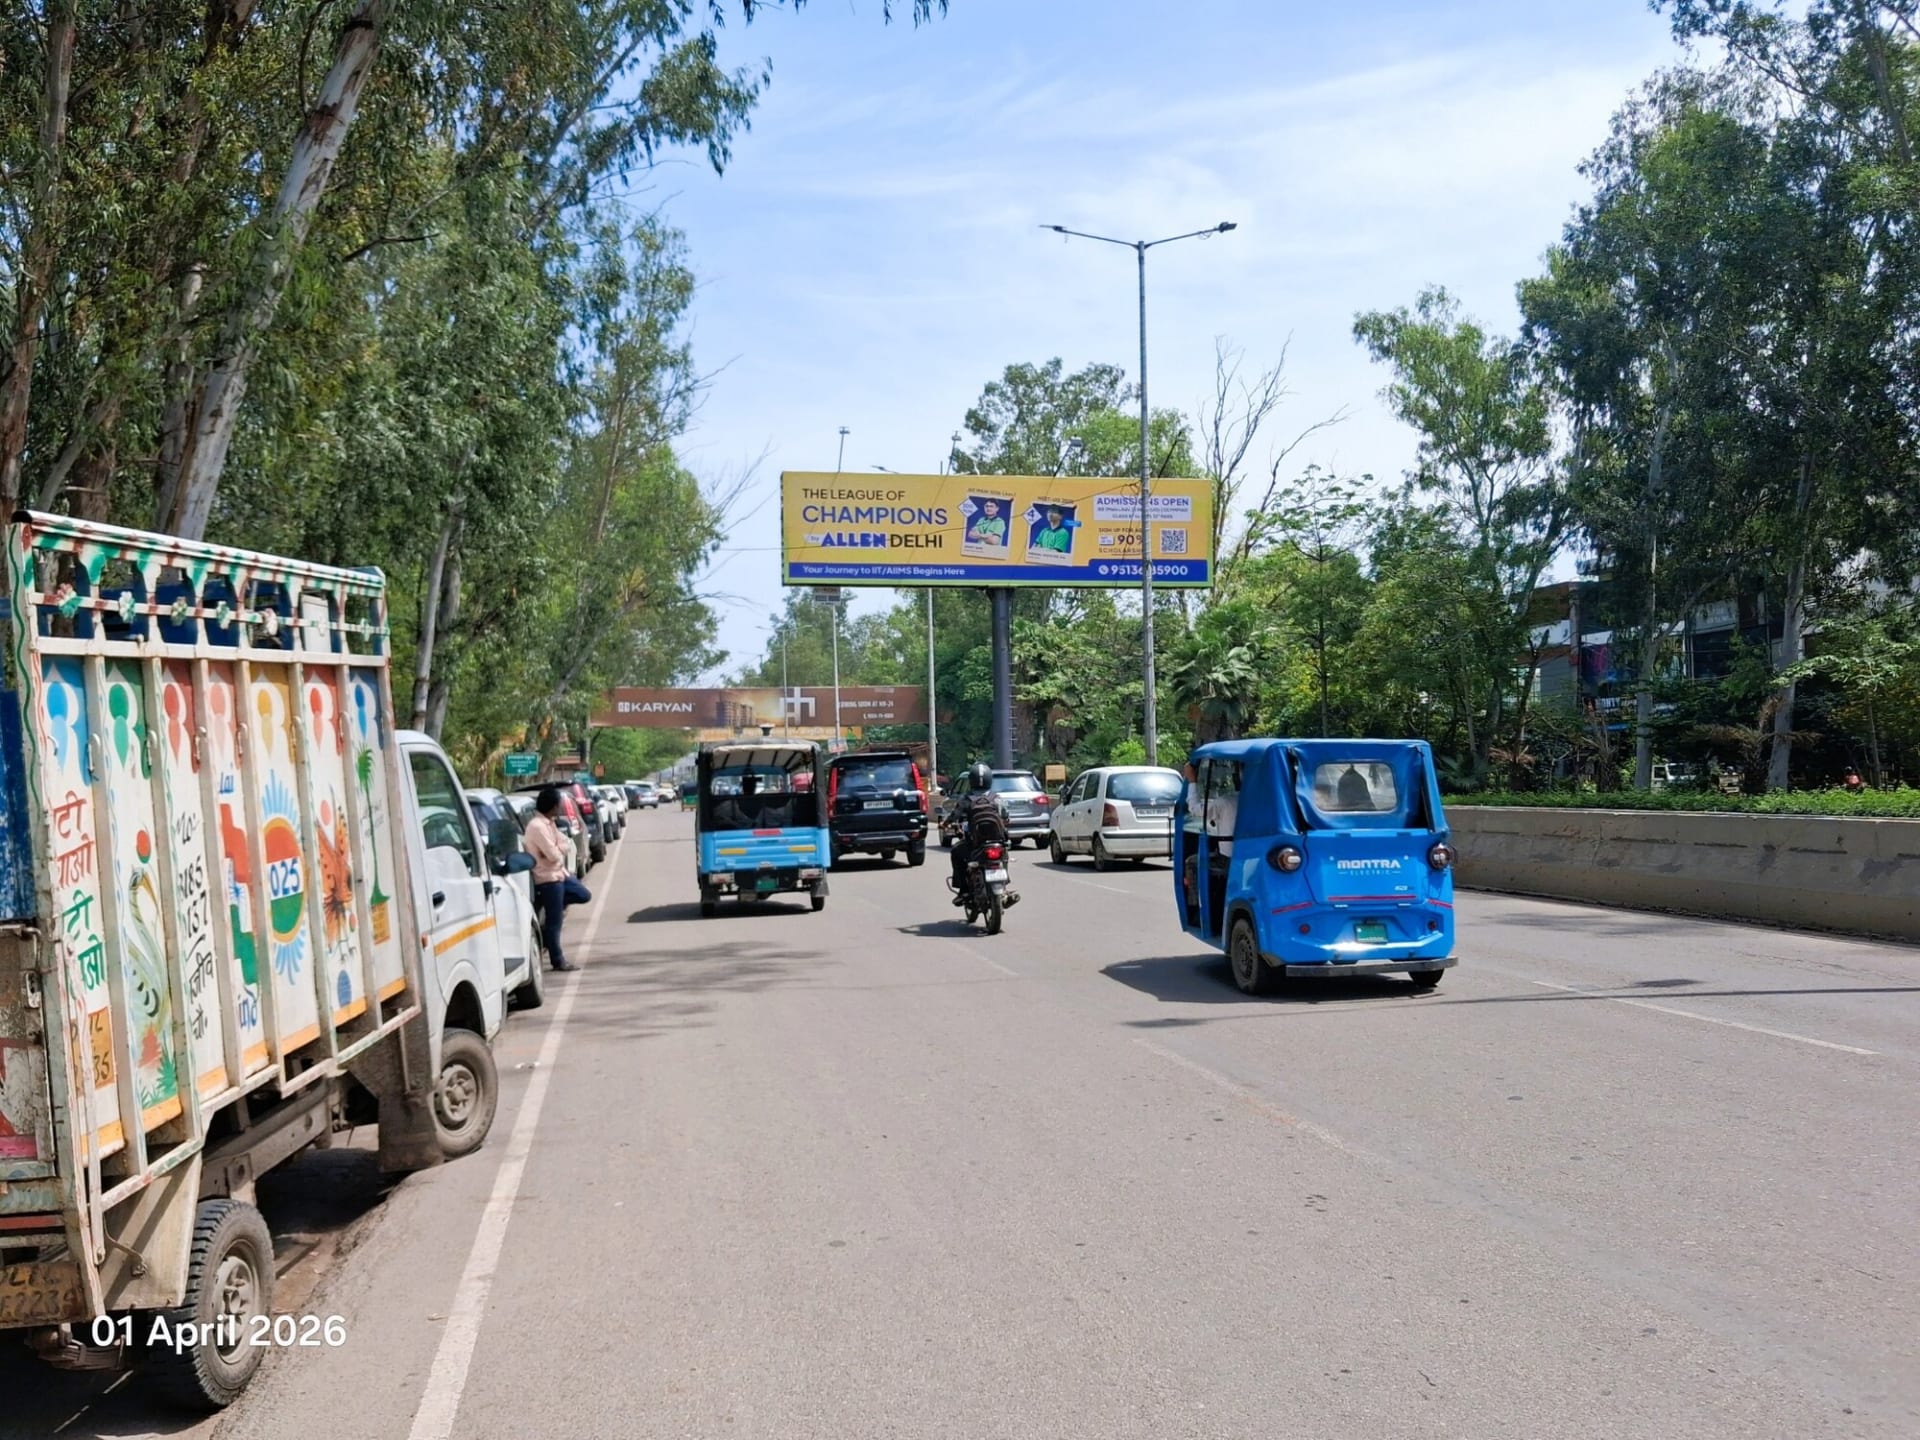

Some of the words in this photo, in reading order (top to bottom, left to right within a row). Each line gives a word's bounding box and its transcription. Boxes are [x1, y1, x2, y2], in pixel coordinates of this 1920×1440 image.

[802, 488, 828, 499] THE
[830, 489, 884, 501] LEAGUE
[886, 490, 905, 501] OF
[1162, 498, 1189, 506] OPEN
[802, 505, 948, 525] CHAMPIONS
[821, 532, 886, 548] ALLEN
[890, 534, 943, 548] DELHI
[803, 565, 823, 574] Your
[824, 566, 858, 576] Journey
[913, 567, 943, 576] Begins
[631, 702, 693, 713] KARYAN
